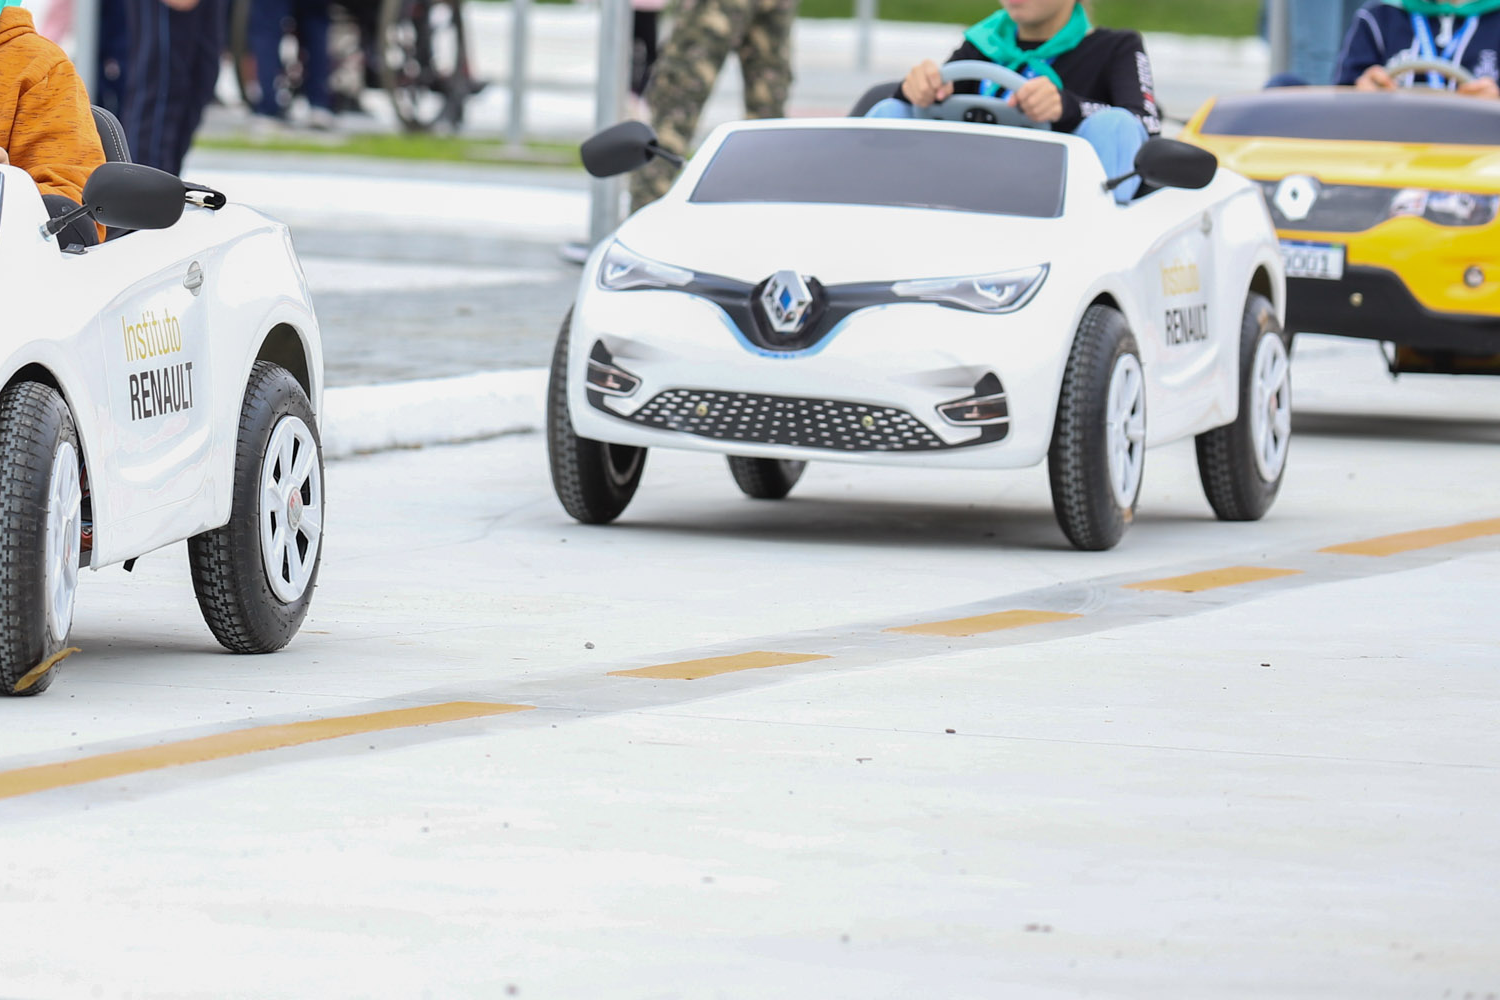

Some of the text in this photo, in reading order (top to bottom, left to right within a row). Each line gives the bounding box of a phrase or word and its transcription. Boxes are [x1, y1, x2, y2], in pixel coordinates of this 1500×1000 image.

[122, 308, 181, 362] Instituto
[1165, 303, 1209, 346] RENAULT
[129, 361, 193, 421] RENAULT
